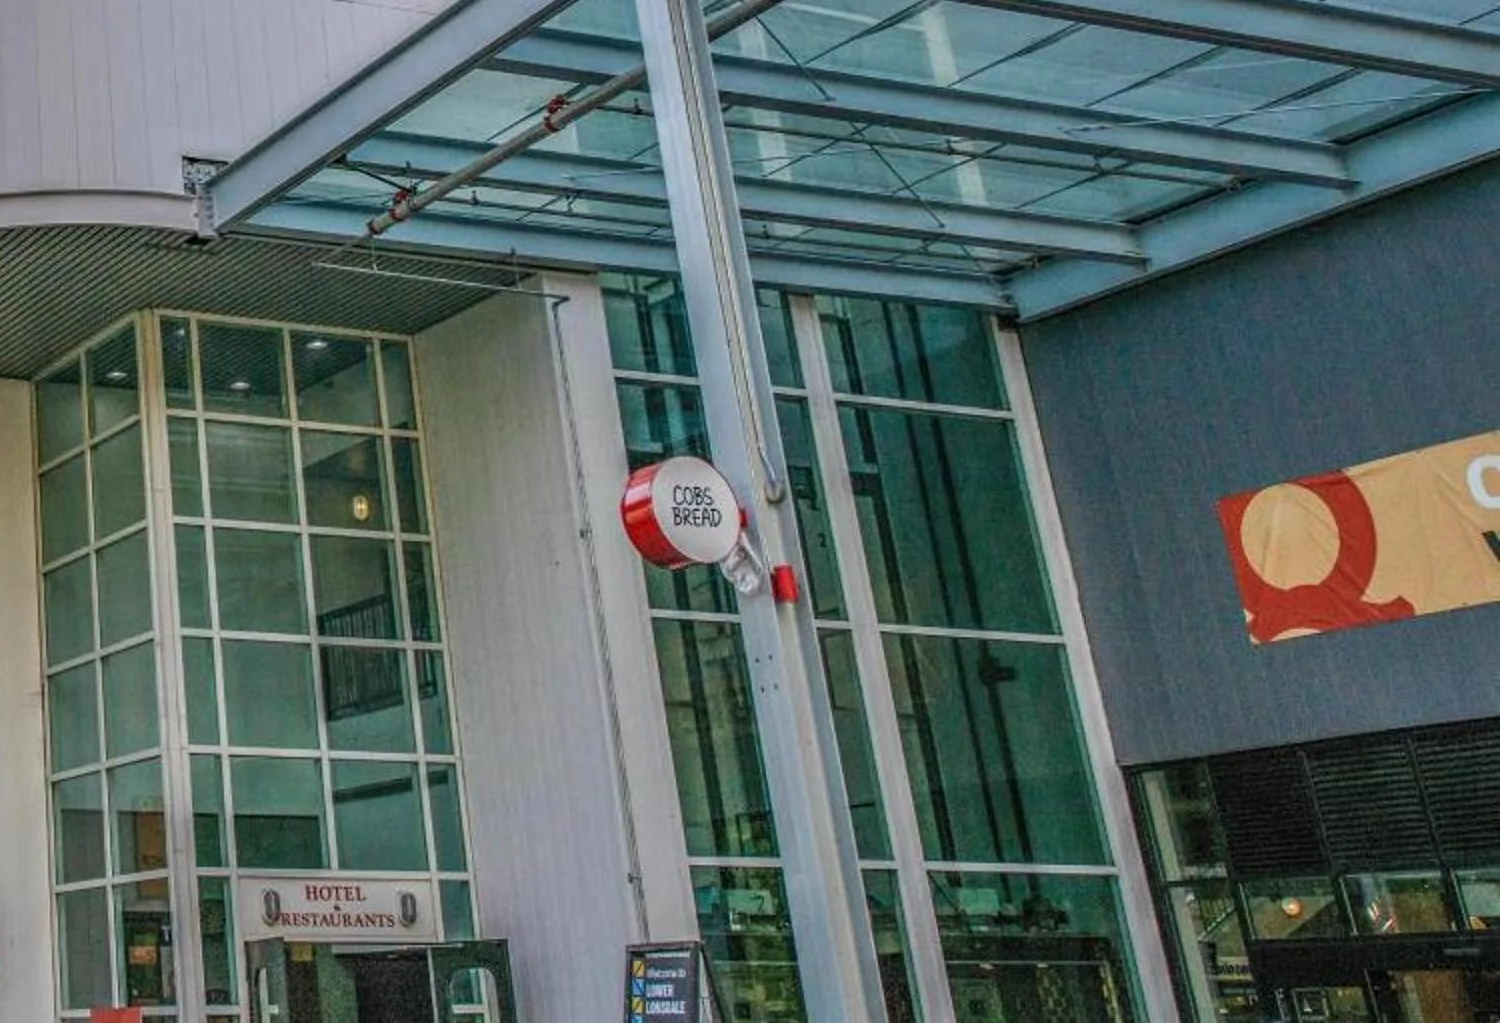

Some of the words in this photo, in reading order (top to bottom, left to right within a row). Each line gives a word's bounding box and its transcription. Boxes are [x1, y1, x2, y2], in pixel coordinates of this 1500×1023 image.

[672, 484, 715, 506] COBS
[670, 506, 723, 528] BREAD
[305, 884, 367, 902] HOTEL
[277, 912, 396, 928] RESTAURANTS
